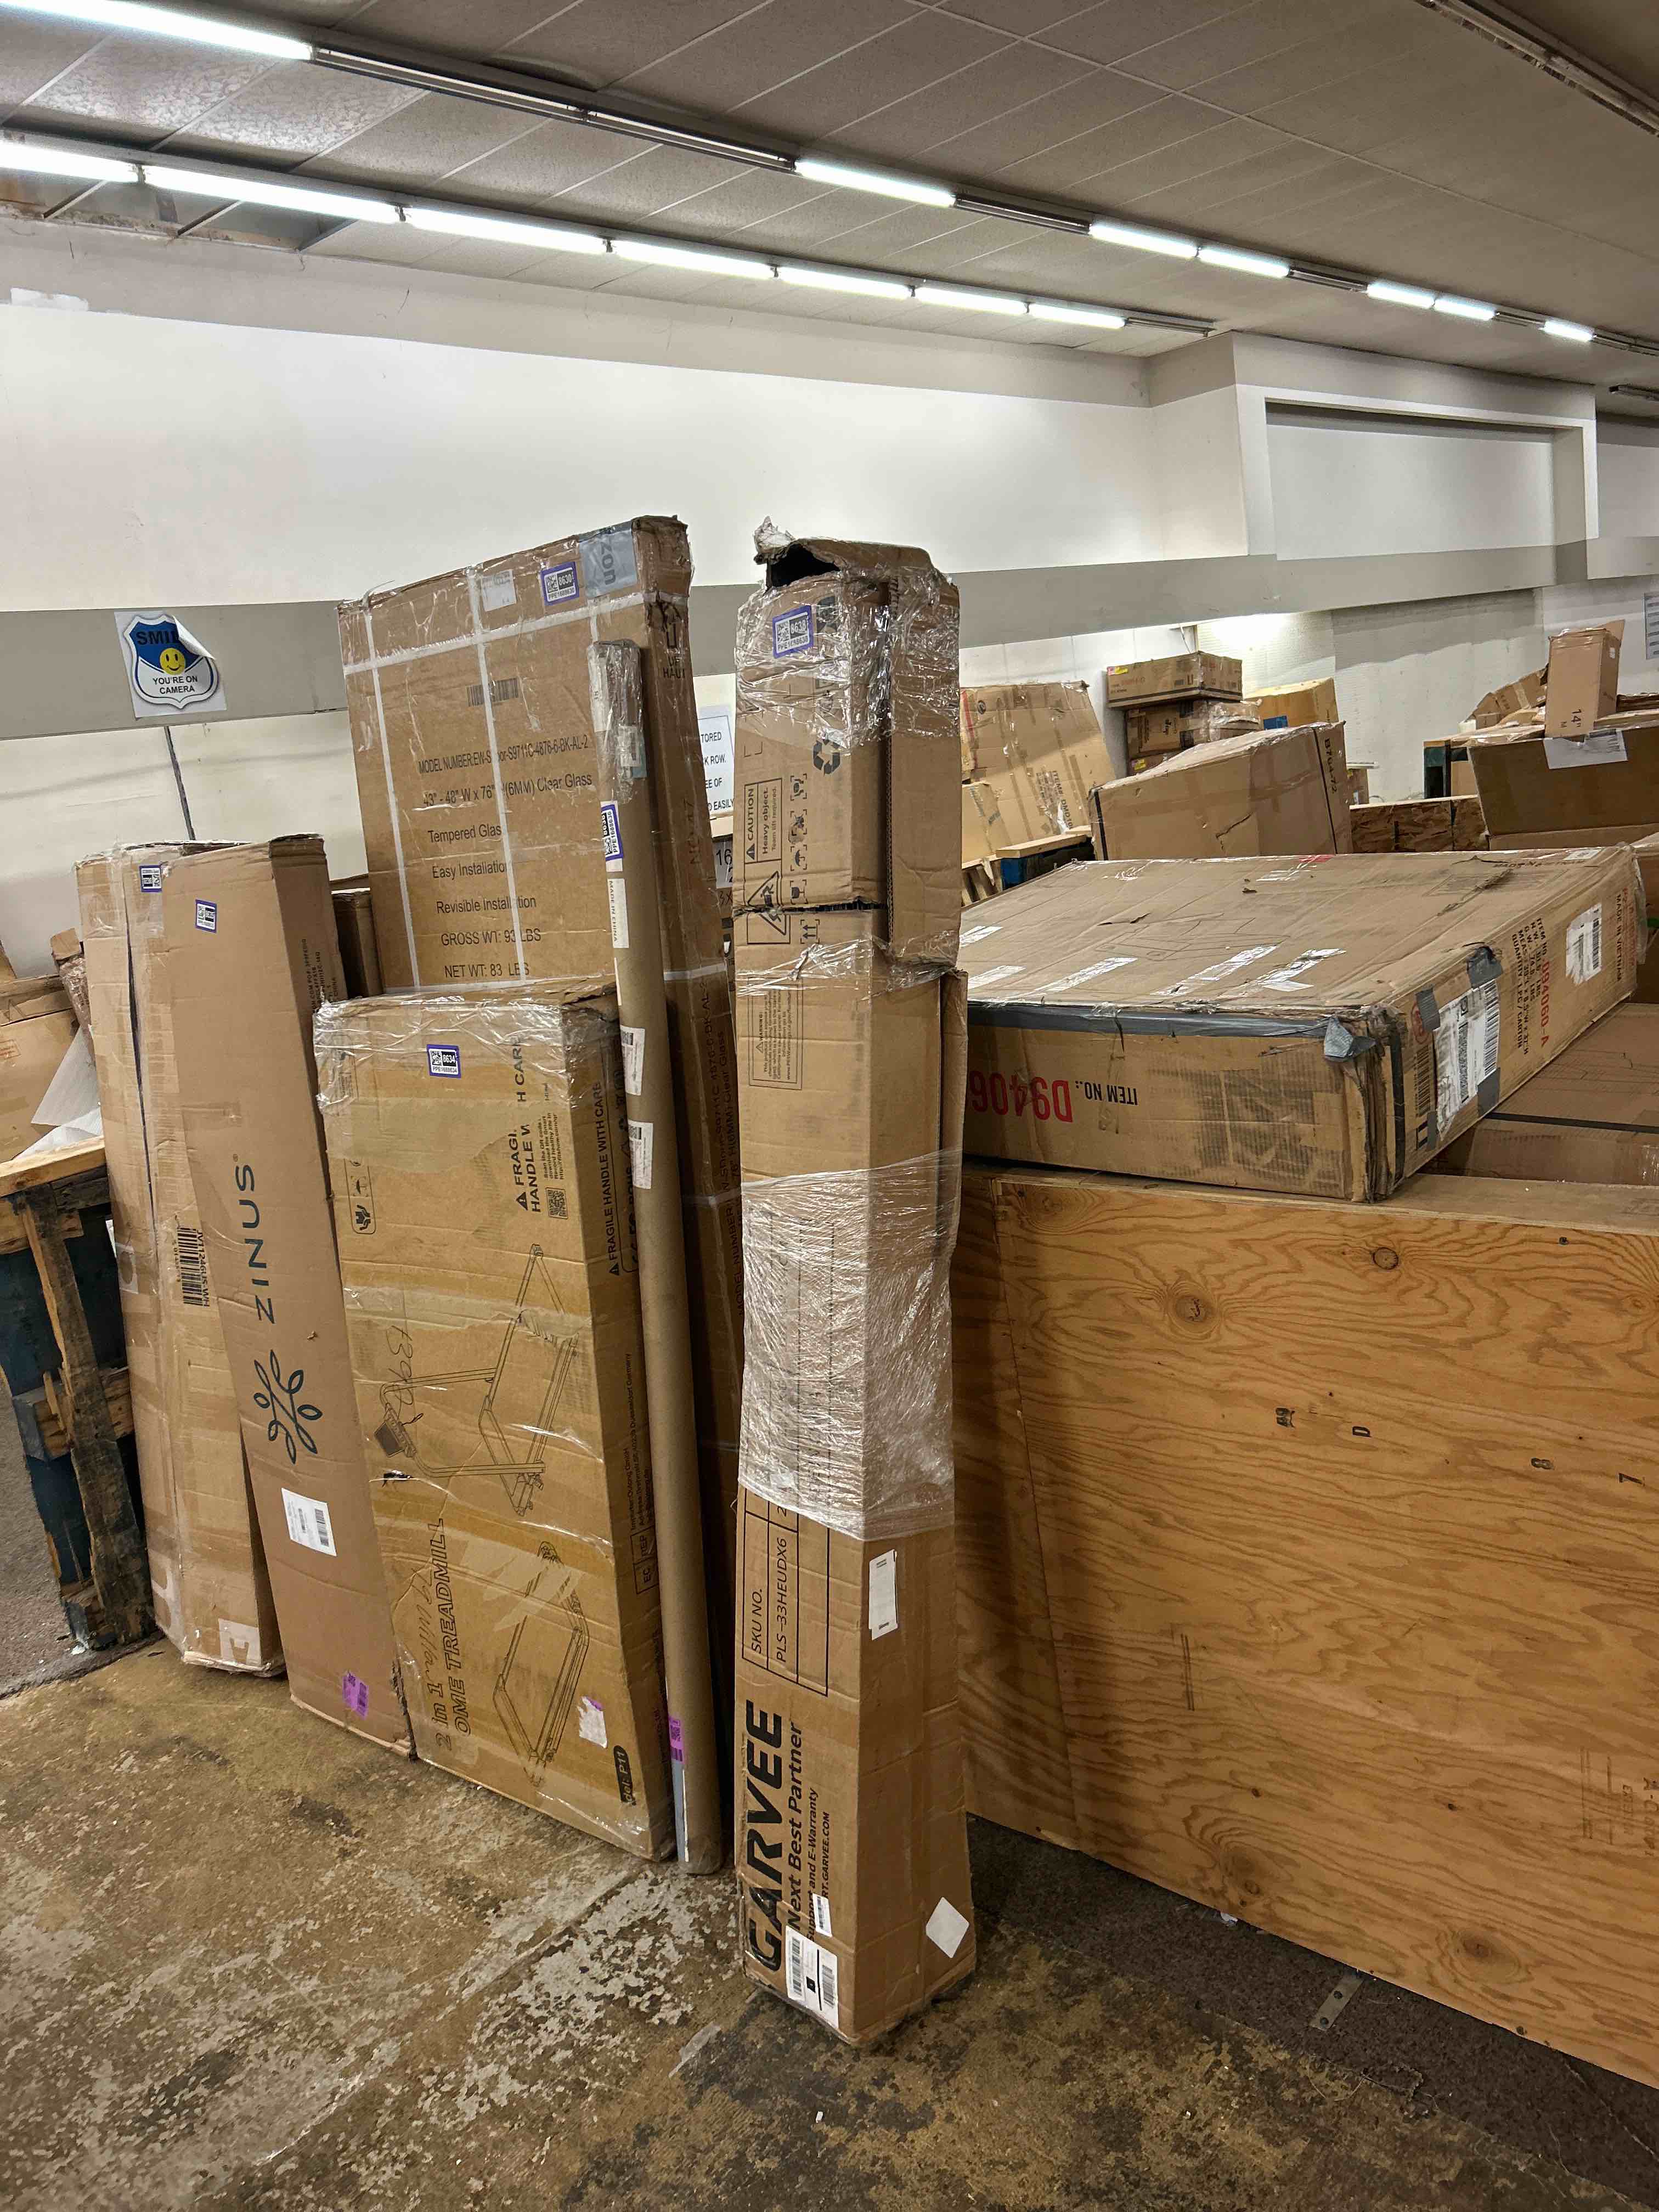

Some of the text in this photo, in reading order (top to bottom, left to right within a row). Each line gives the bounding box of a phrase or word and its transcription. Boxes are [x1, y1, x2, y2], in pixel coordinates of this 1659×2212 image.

[558, 574, 572, 585] 8630
[138, 630, 180, 645] SMIL
[153, 676, 184, 685] YOU'RE
[701, 732, 721, 743] TORED
[419, 759, 442, 774] MODEL
[710, 754, 726, 764] ROW.
[461, 788, 471, 801] W
[481, 783, 495, 799] 76"
[537, 776, 562, 792] Clear
[565, 772, 592, 788] Glass
[714, 778, 723, 787] OF
[428, 823, 501, 844] Tempered Glas
[432, 866, 456, 881] Easy
[437, 895, 536, 913] Revisible Installtion
[441, 928, 541, 946] GROSS WT: 93 LBS
[444, 963, 529, 978] NET WT: 83 LBS
[1107, 1084, 1138, 1105] ITEM
[507, 1129, 526, 1186] FRAGI
[521, 1141, 541, 1212] HANDLE
[591, 1081, 618, 1260] FRAGILE HANDLE WITH CARE
[235, 1164, 276, 1324] ZINUS
[427, 1518, 462, 1670] TREADMILL
[775, 1536, 788, 1663] PLS-33HEUDX6
[751, 1588, 762, 1654] SKU NO.
[427, 1681, 443, 1699] 1
[431, 1703, 448, 1728] in
[448, 1677, 471, 1736] OME
[435, 1734, 452, 1751] 2
[616, 1751, 629, 1774] P11
[746, 1699, 782, 1971] GARVEE
[787, 1720, 802, 1932] Next Best Partner
[807, 1786, 820, 1861] E-Warranty
[820, 1812, 831, 1898] RT.GARVEE.COM
[806, 1863, 816, 1888] and
